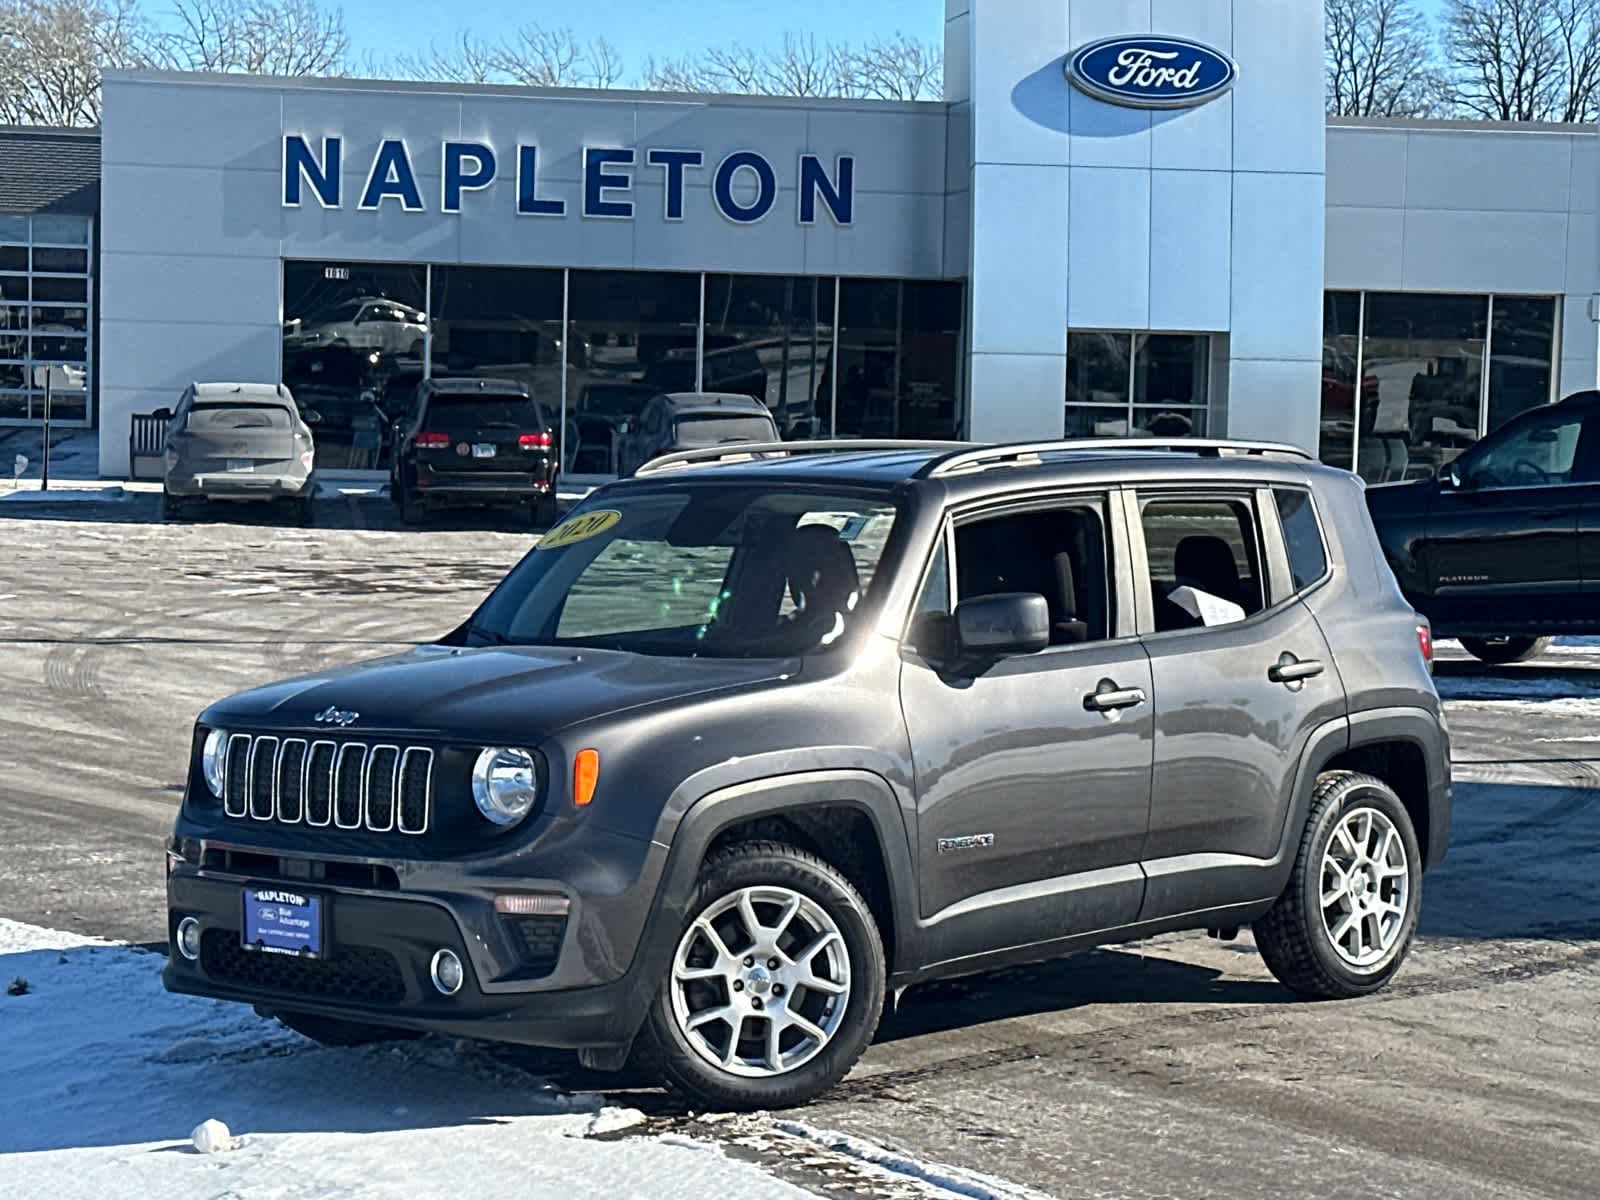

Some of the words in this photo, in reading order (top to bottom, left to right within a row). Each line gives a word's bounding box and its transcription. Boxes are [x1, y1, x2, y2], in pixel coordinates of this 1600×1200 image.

[1108, 48, 1202, 89] Ford
[281, 133, 855, 226] NAPLETON
[544, 512, 612, 545] 2020
[314, 705, 360, 727] Jeep
[937, 833, 995, 852] RENEGADE
[257, 891, 305, 906] NAPLETON
